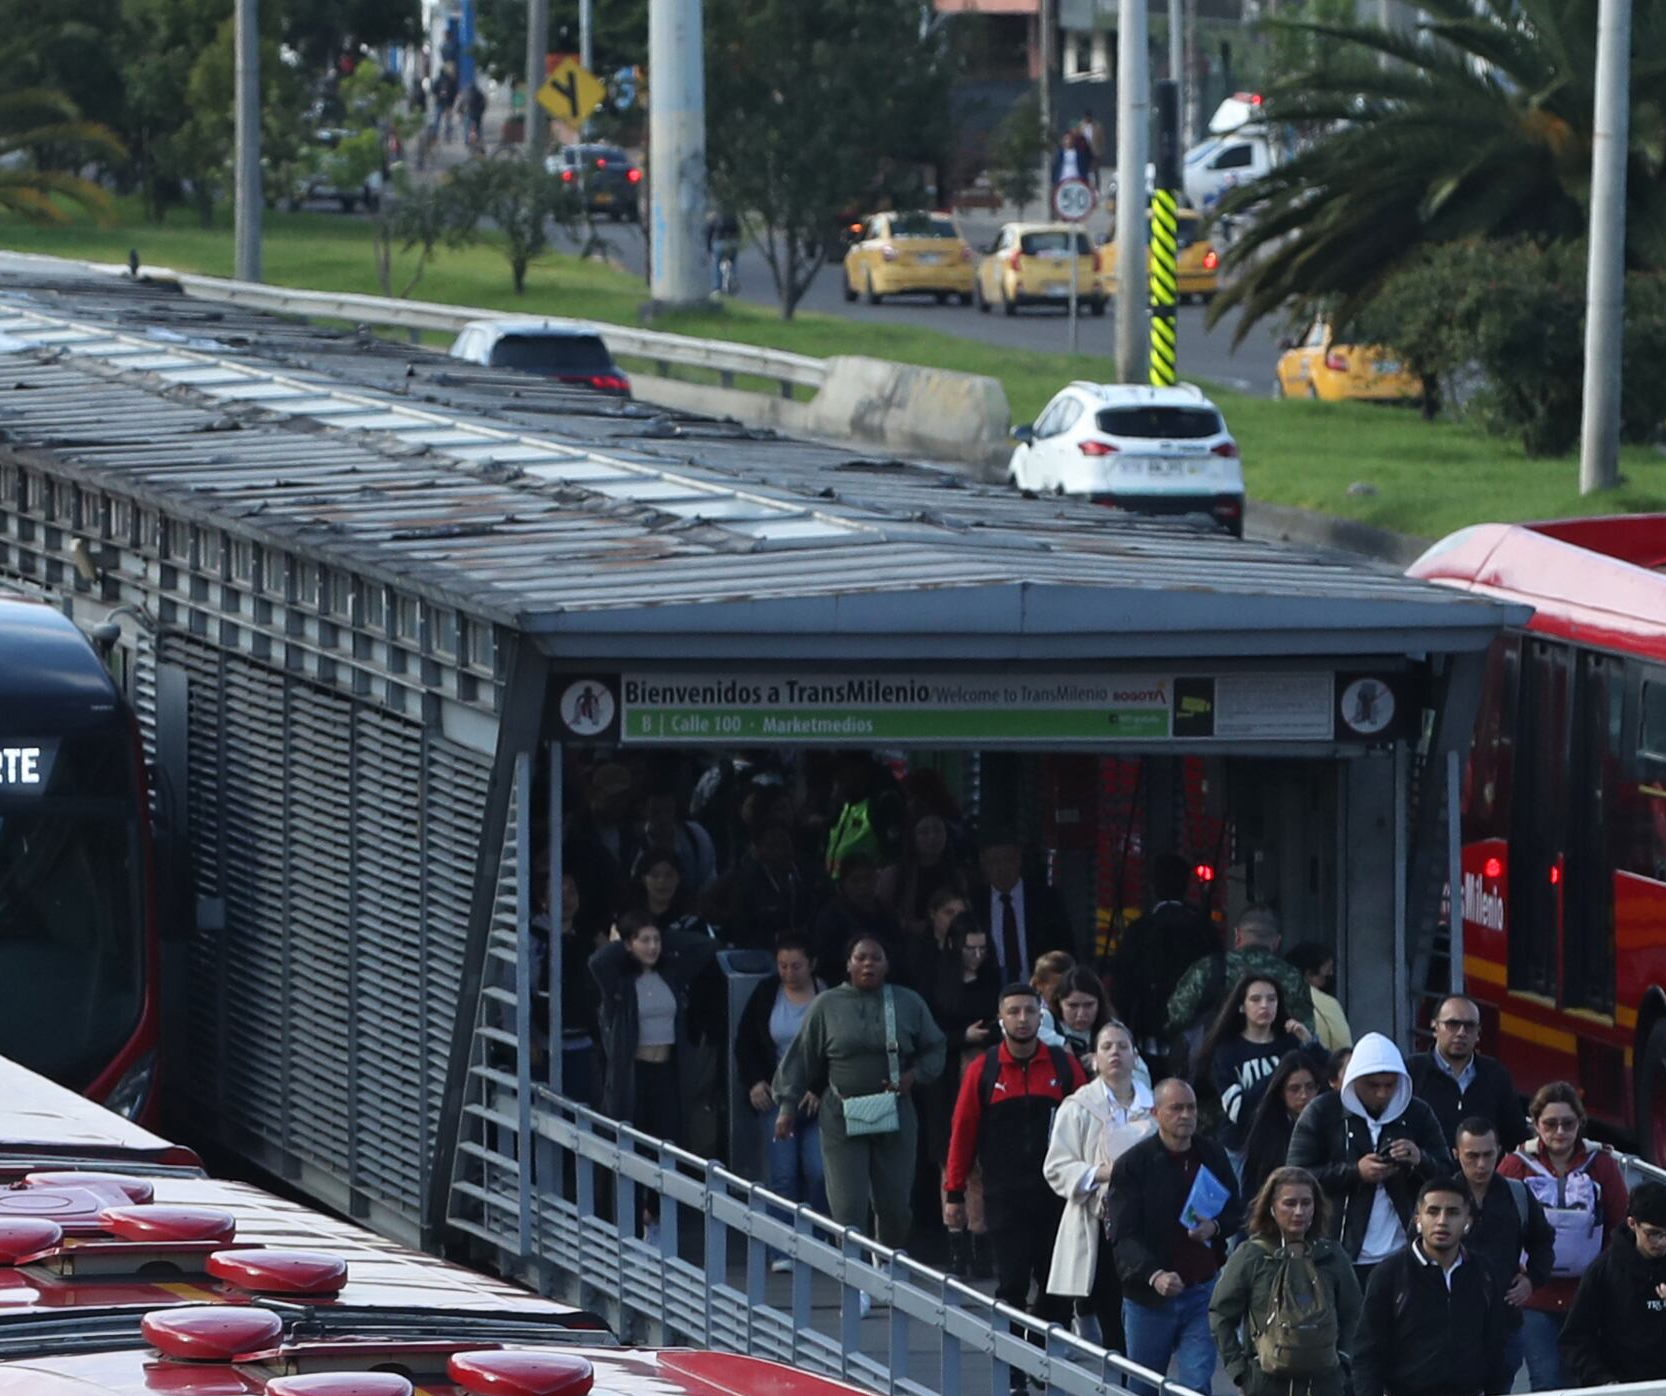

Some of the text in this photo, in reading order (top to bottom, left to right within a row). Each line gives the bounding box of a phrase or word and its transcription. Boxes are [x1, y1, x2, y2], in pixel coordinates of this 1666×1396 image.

[1061, 187, 1089, 210] 50
[625, 680, 762, 704] Bienvenidos
[767, 687, 781, 704] a
[1004, 687, 1017, 703] to
[1020, 685, 1108, 703] TransMilenio
[641, 715, 874, 735] B Calle 100 Marketmedios
